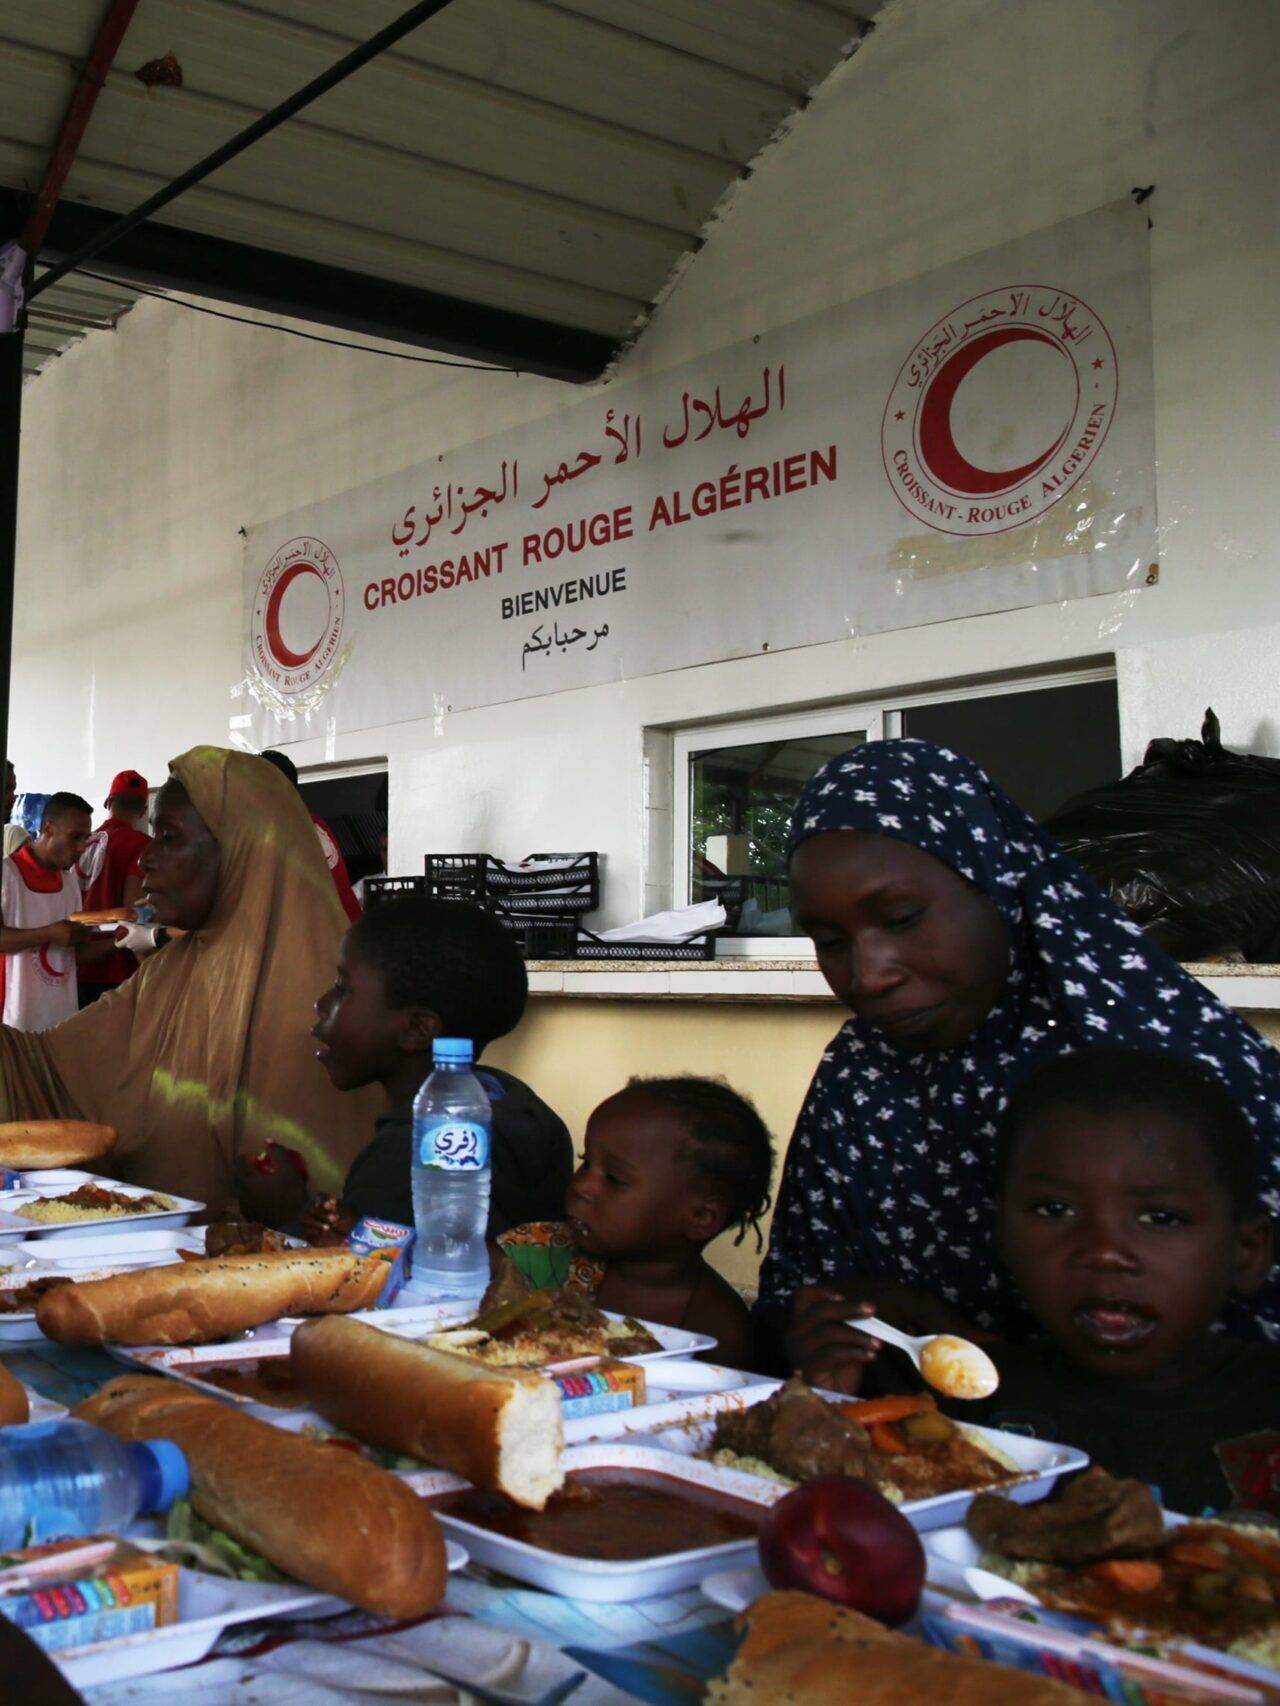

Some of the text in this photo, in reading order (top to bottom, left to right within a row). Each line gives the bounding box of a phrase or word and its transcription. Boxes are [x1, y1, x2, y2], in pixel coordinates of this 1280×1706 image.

[363, 444, 839, 611] CROISSANT ROUGE ALGÉRIEN
[392, 364, 785, 558] الهلال الأحمر الجزائري
[502, 568, 628, 619] BIENVENUE
